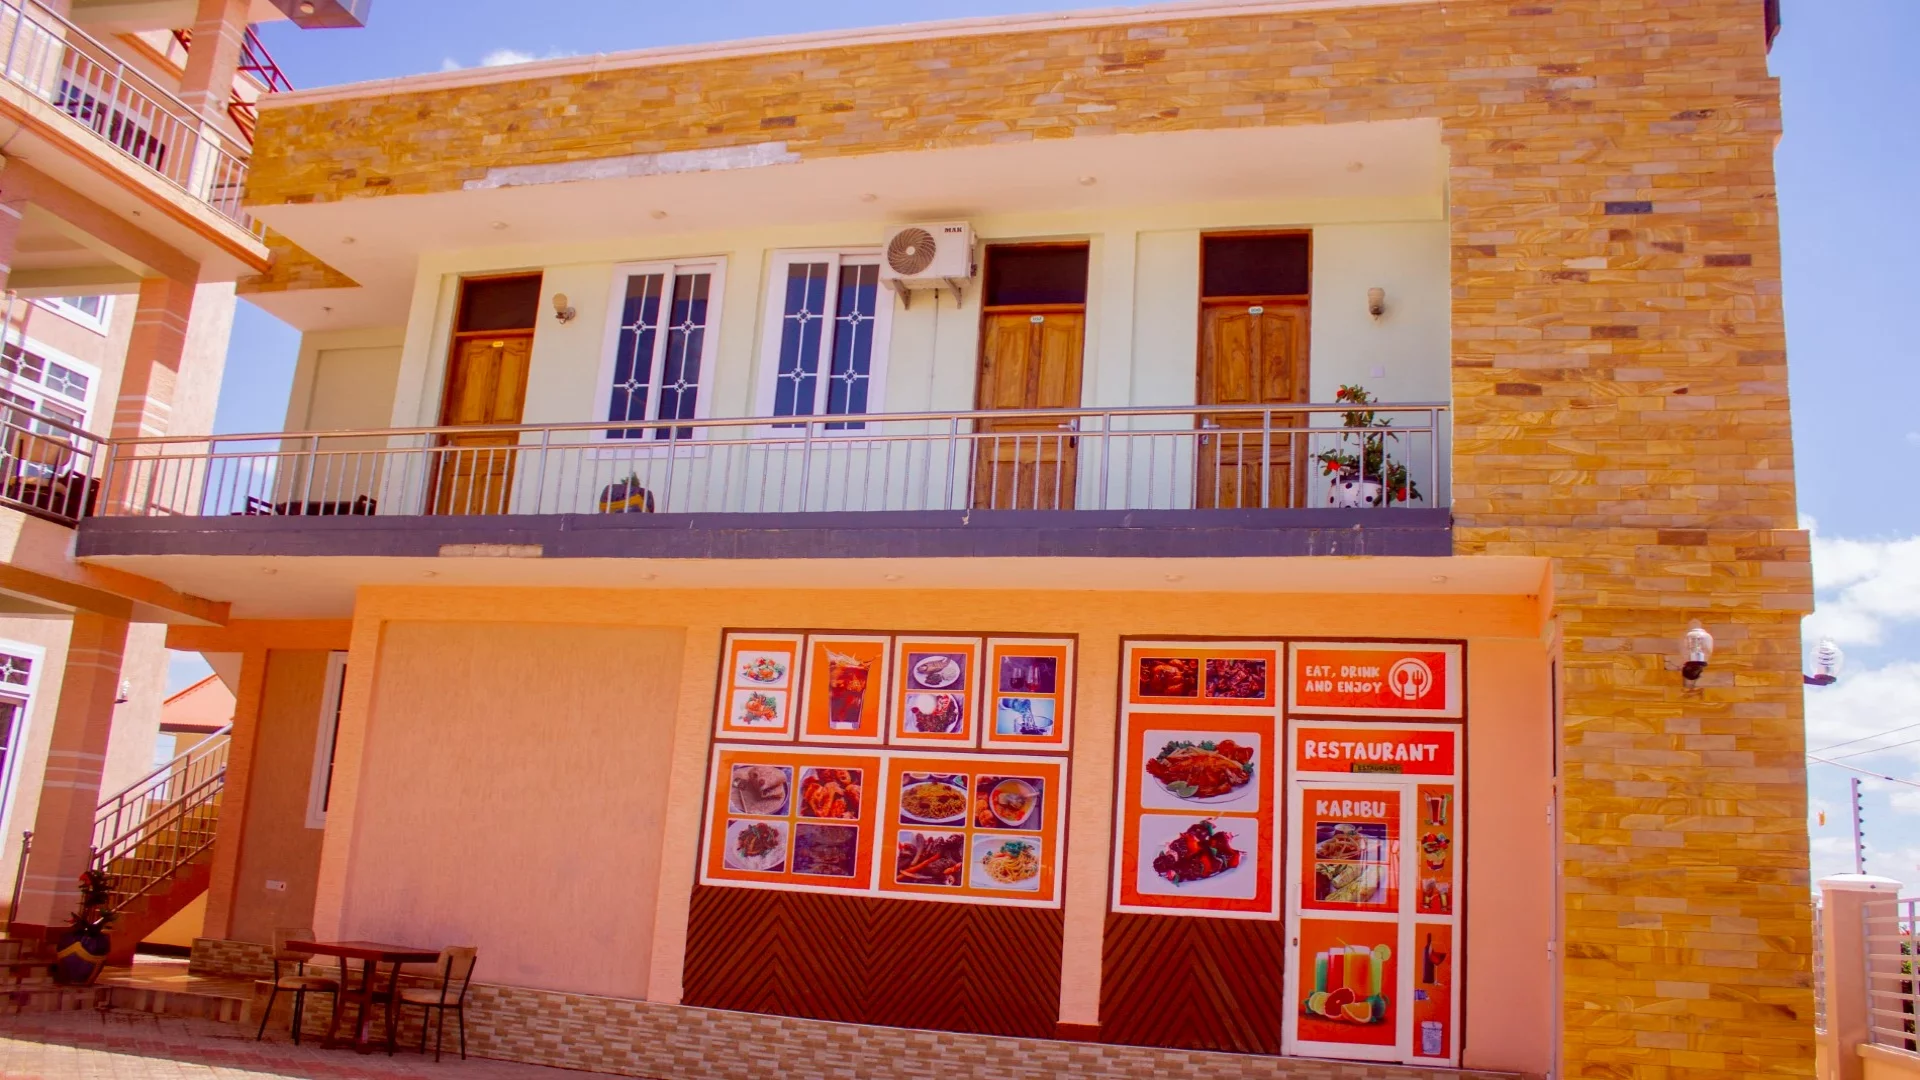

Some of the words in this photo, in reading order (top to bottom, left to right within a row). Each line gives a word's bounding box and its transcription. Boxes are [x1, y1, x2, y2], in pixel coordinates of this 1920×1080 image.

[1305, 665, 1336, 678] EAT,
[1340, 665, 1380, 678] DRINK
[1305, 680, 1333, 692] AND
[1337, 681, 1382, 693] ENJOY
[1305, 740, 1439, 761] RESTAURANT
[1316, 800, 1386, 817] KARIBU
